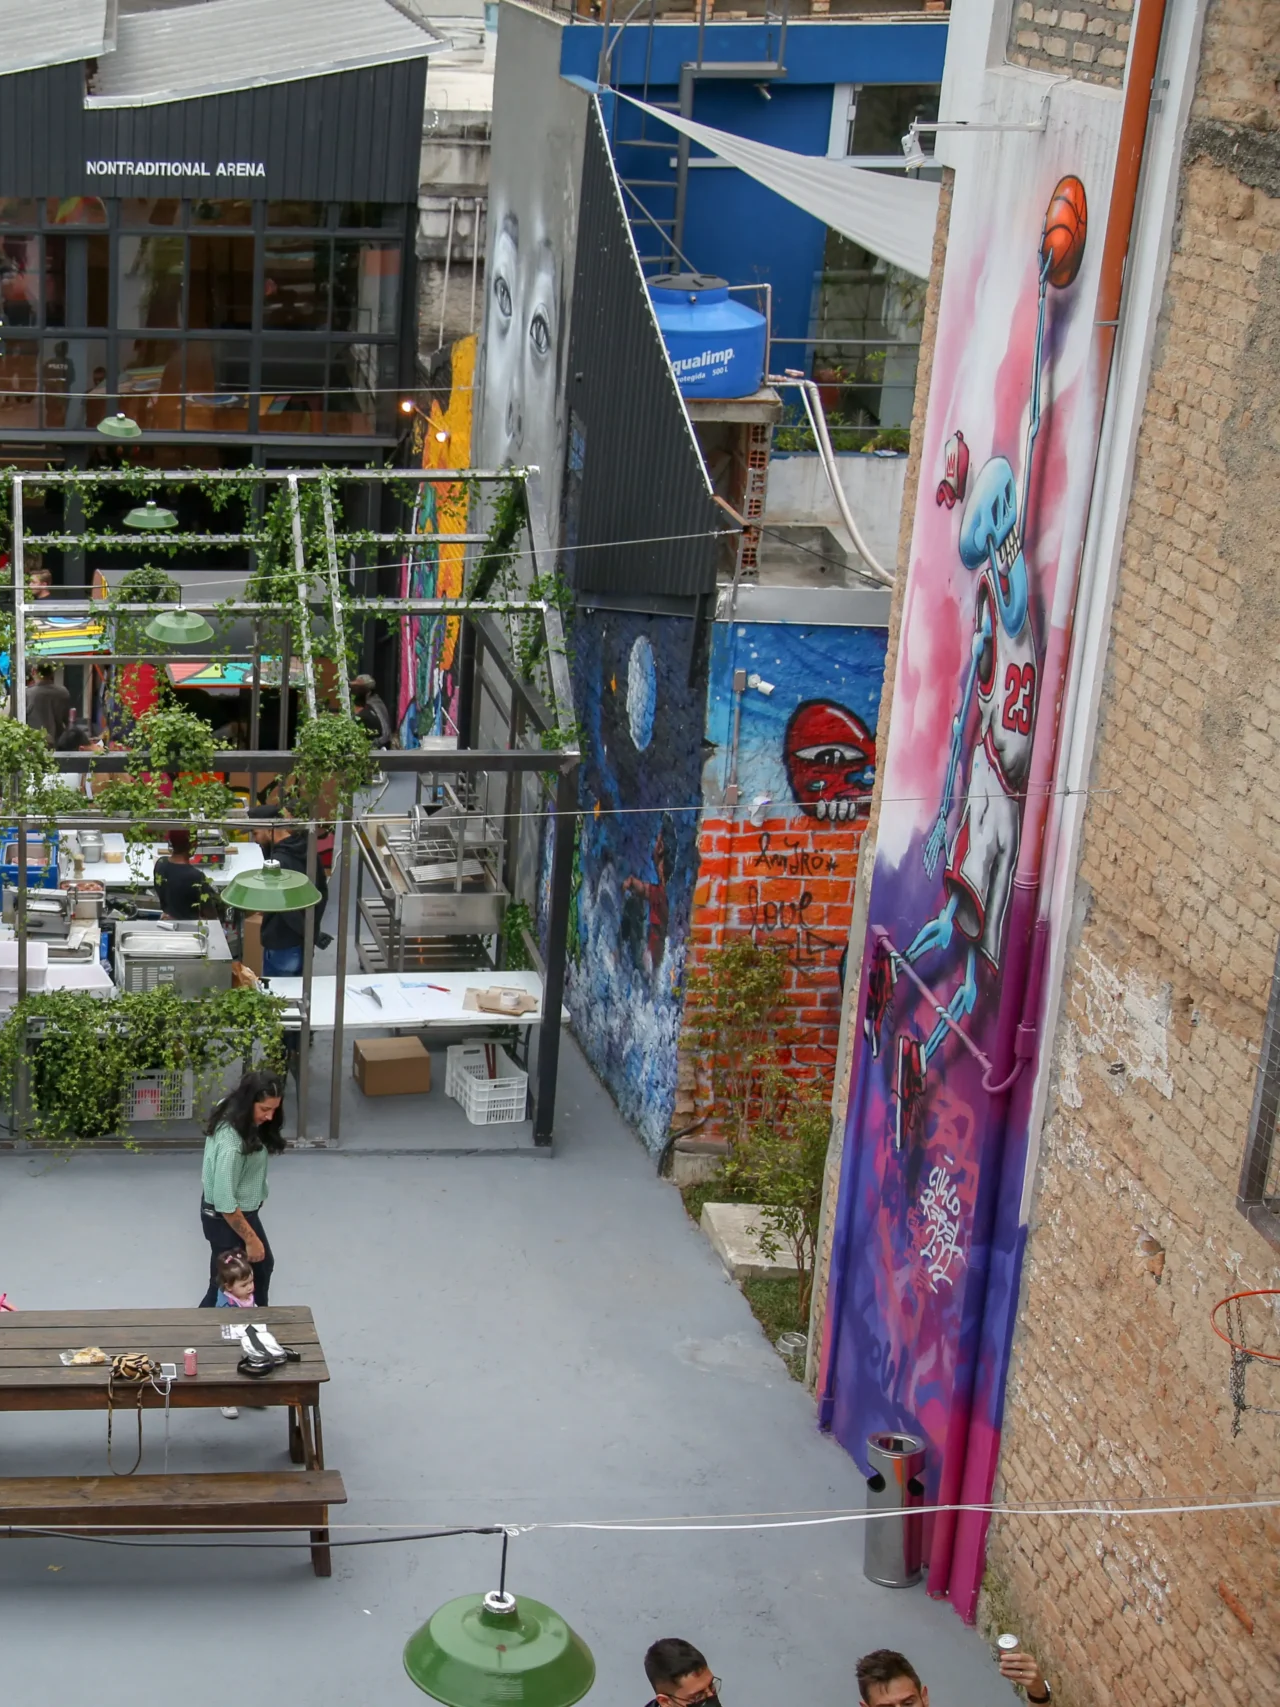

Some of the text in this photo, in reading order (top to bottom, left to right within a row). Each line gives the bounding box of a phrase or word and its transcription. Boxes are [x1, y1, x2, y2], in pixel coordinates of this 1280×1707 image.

[86, 161, 266, 177] NONTRADITIONAL ARENA
[672, 347, 735, 376] qualimp
[676, 371, 706, 384] rotegida
[1002, 661, 1036, 737] 23
